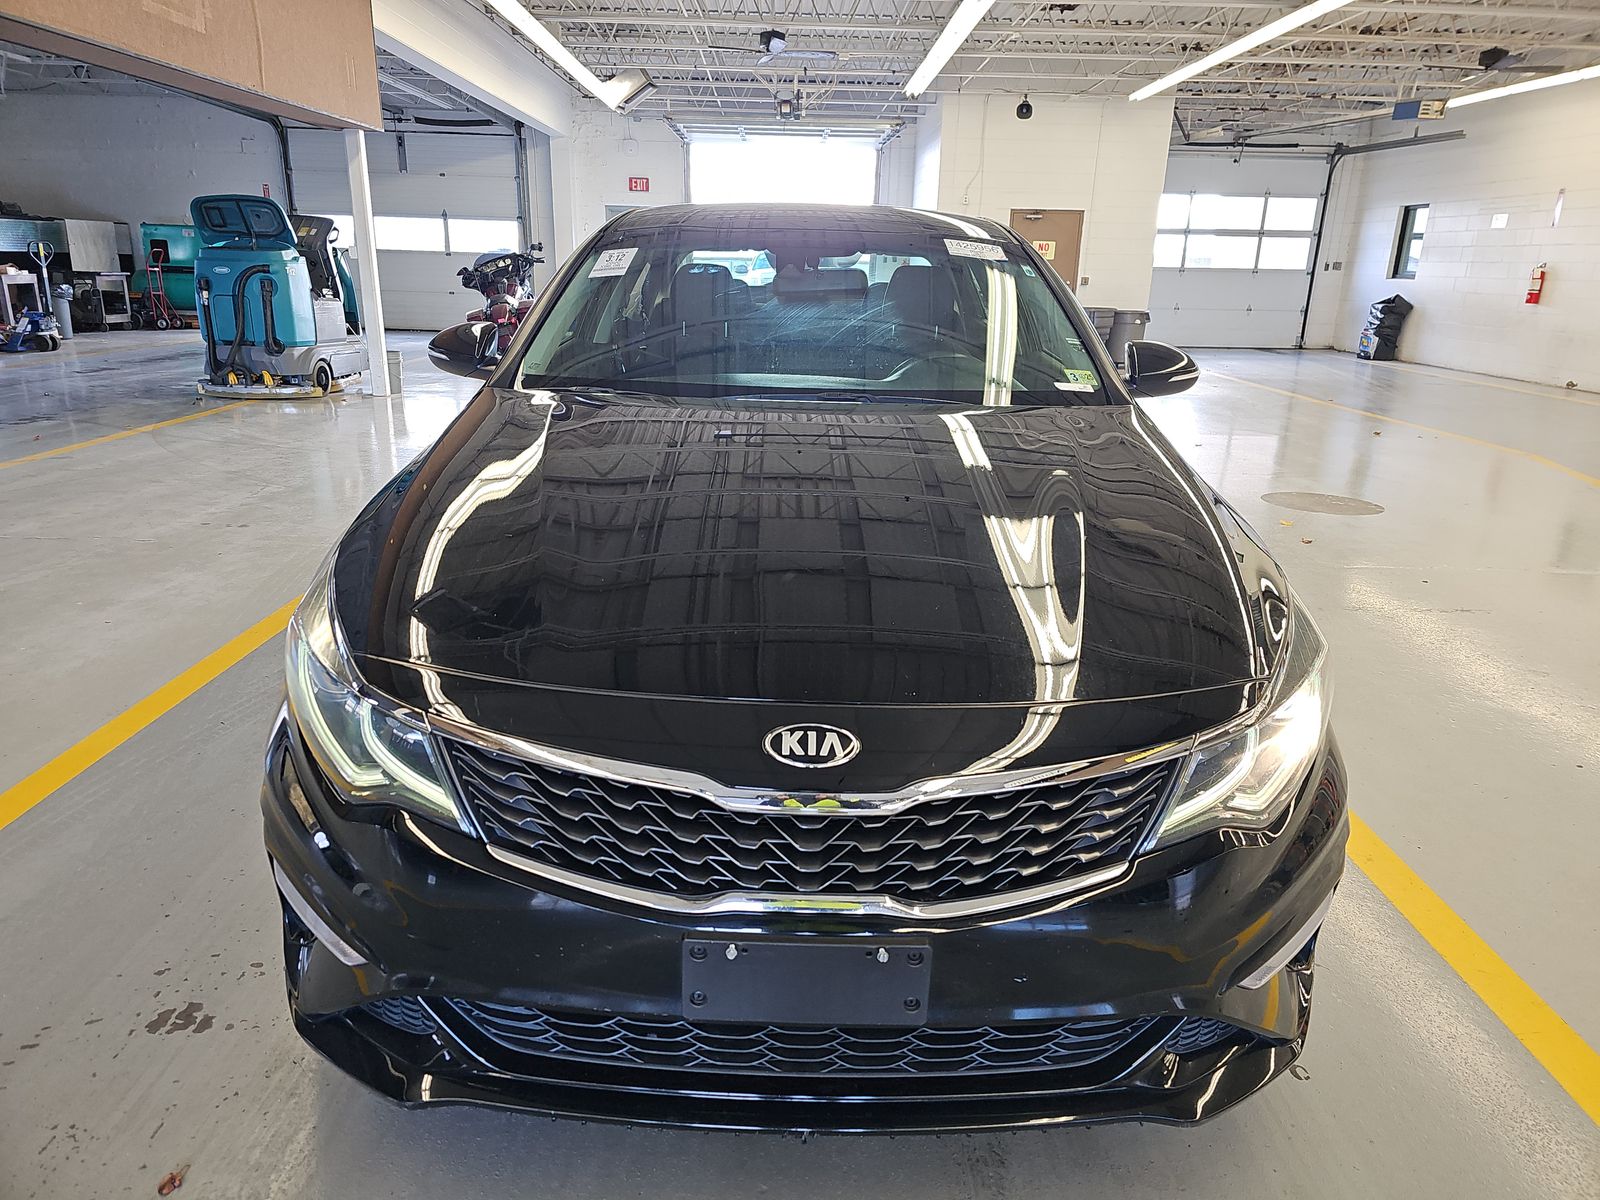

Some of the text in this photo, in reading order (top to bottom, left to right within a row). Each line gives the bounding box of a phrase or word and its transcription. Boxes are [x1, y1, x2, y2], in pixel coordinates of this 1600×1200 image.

[632, 179, 647, 190] EXIT
[1038, 243, 1050, 251] NO
[1070, 373, 1078, 381] 3
[781, 731, 844, 757] KIA
